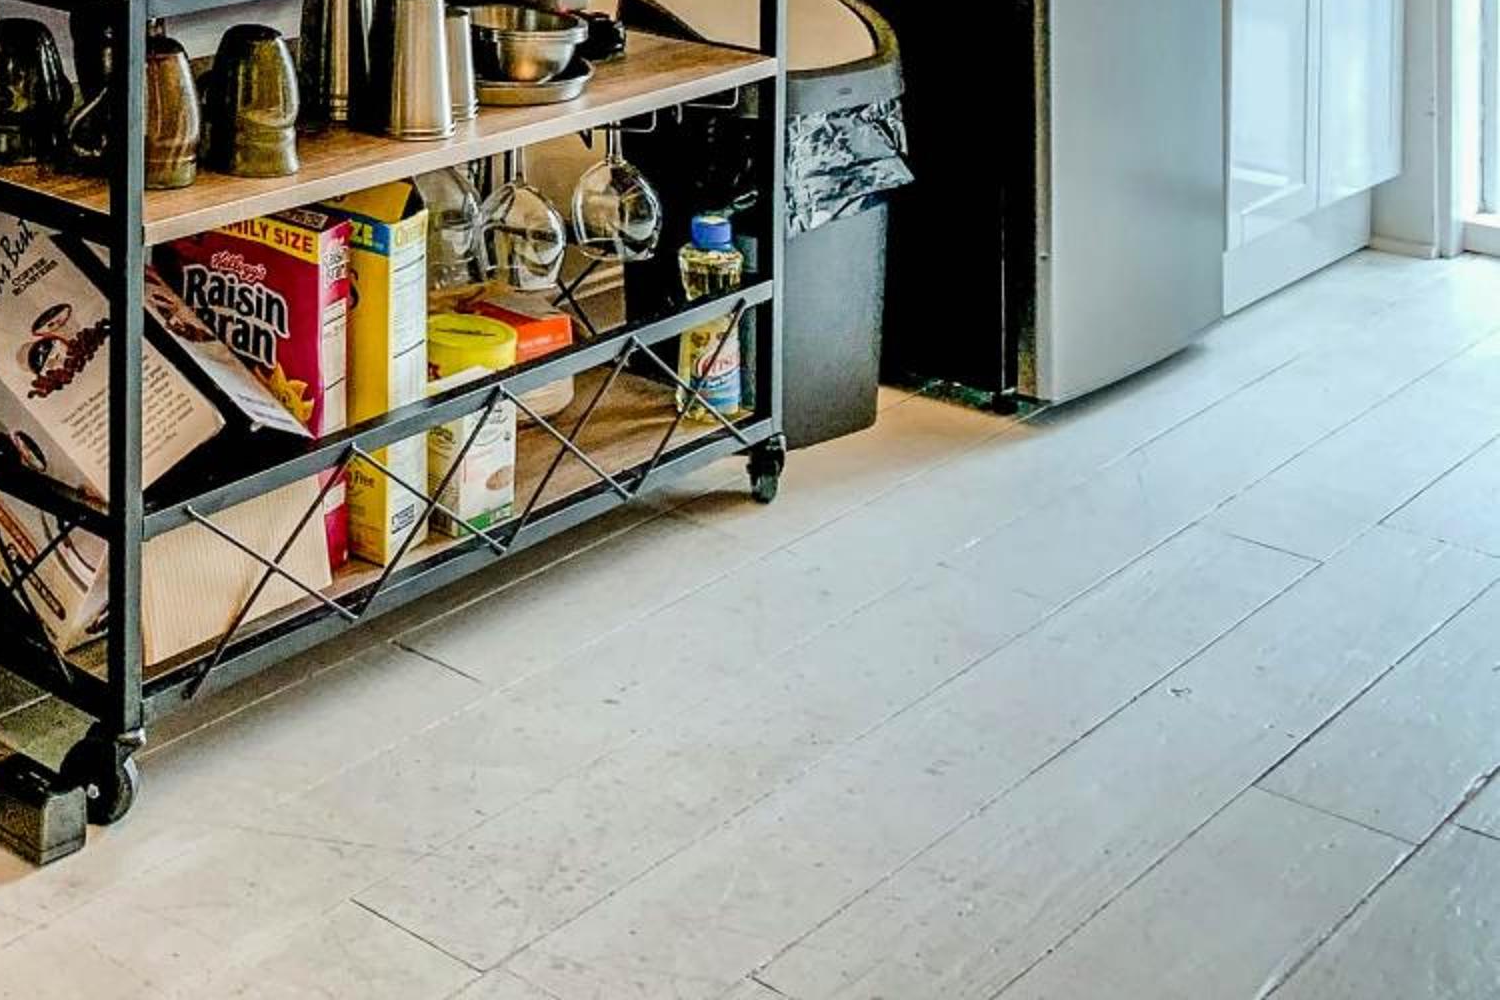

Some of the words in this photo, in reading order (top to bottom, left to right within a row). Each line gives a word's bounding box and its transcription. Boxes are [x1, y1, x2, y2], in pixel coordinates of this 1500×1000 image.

[0, 219, 39, 269] Best
[222, 219, 268, 241] MILY
[274, 227, 314, 254] SIZE
[211, 249, 267, 283] Kellogg's
[184, 264, 290, 338] Raisin
